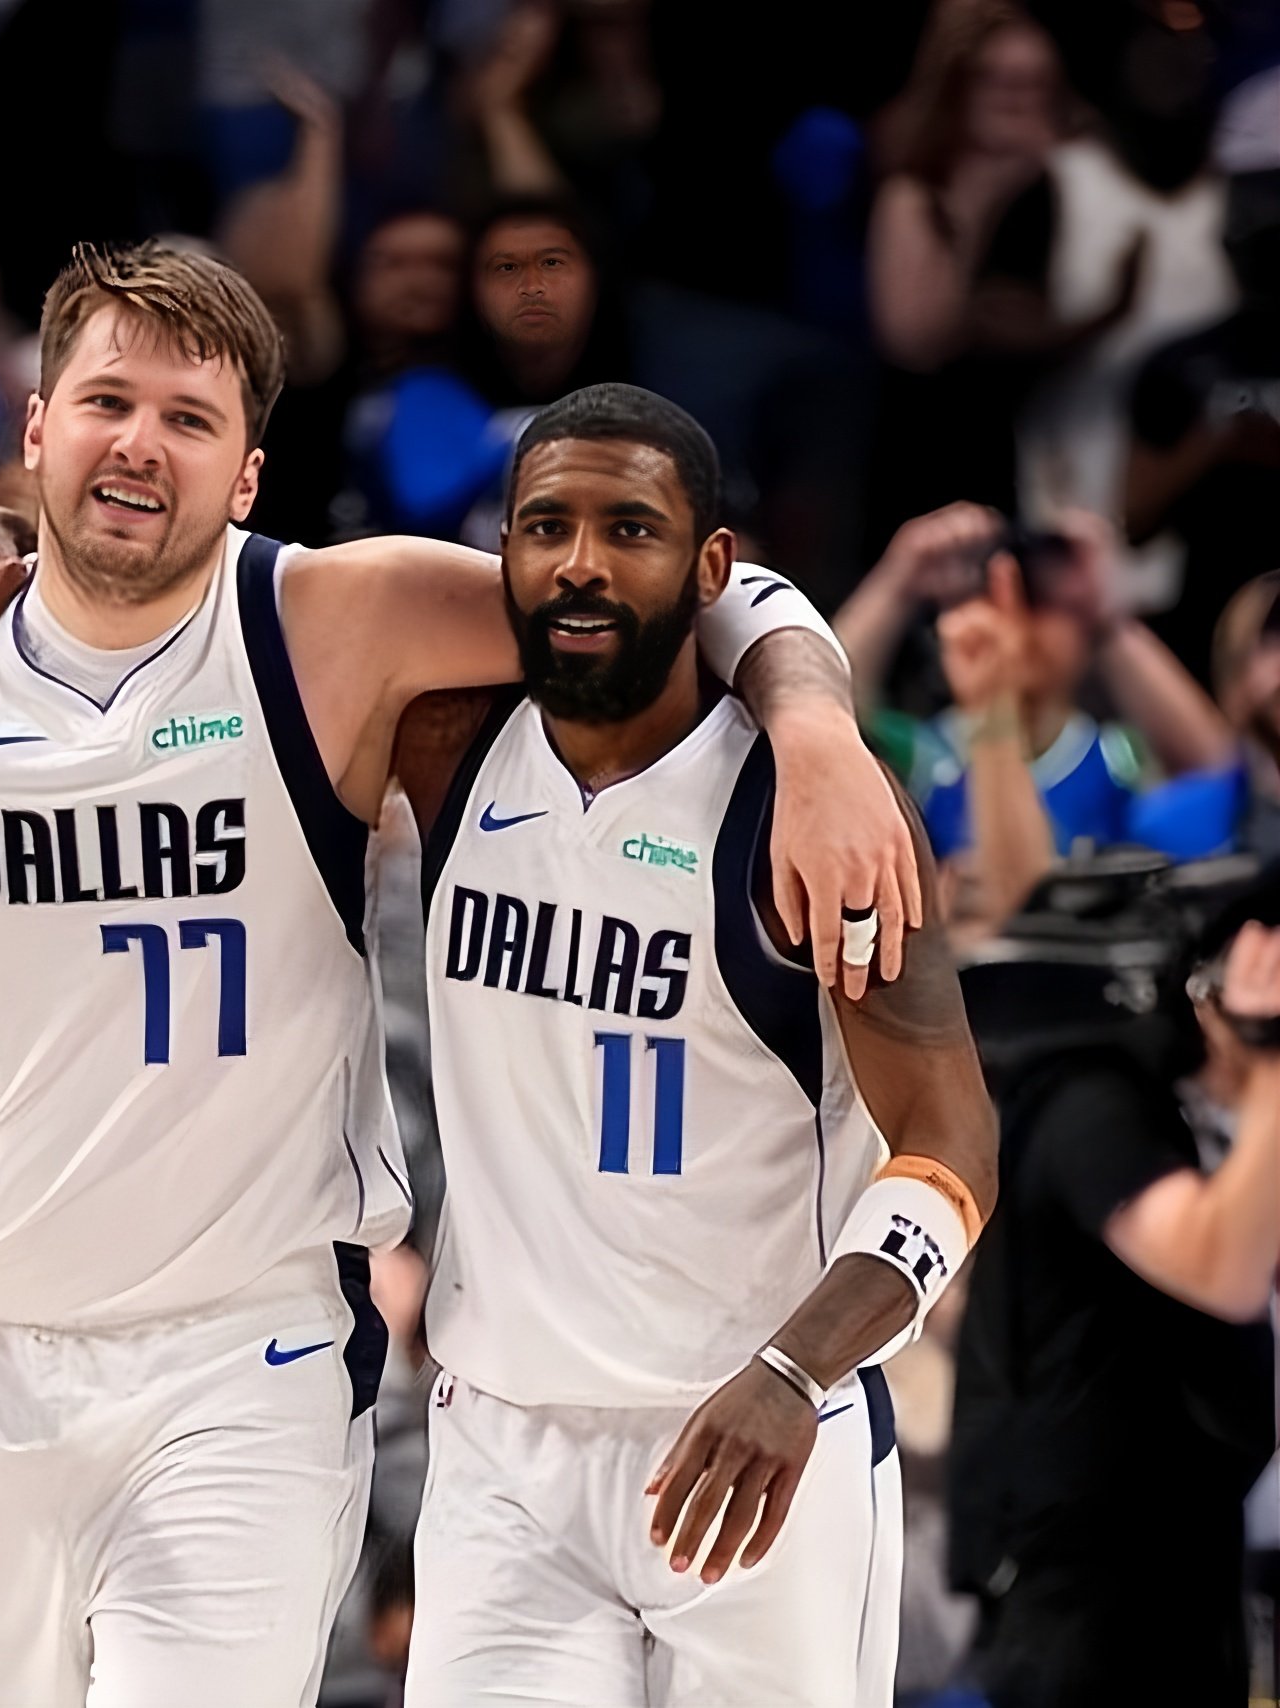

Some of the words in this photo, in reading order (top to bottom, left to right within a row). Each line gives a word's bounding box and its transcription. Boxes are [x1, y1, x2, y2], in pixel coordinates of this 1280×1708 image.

[151, 714, 245, 750] chime
[99, 918, 247, 1066] 77
[445, 884, 693, 1020] DALLAS
[593, 1030, 687, 1176] 11
